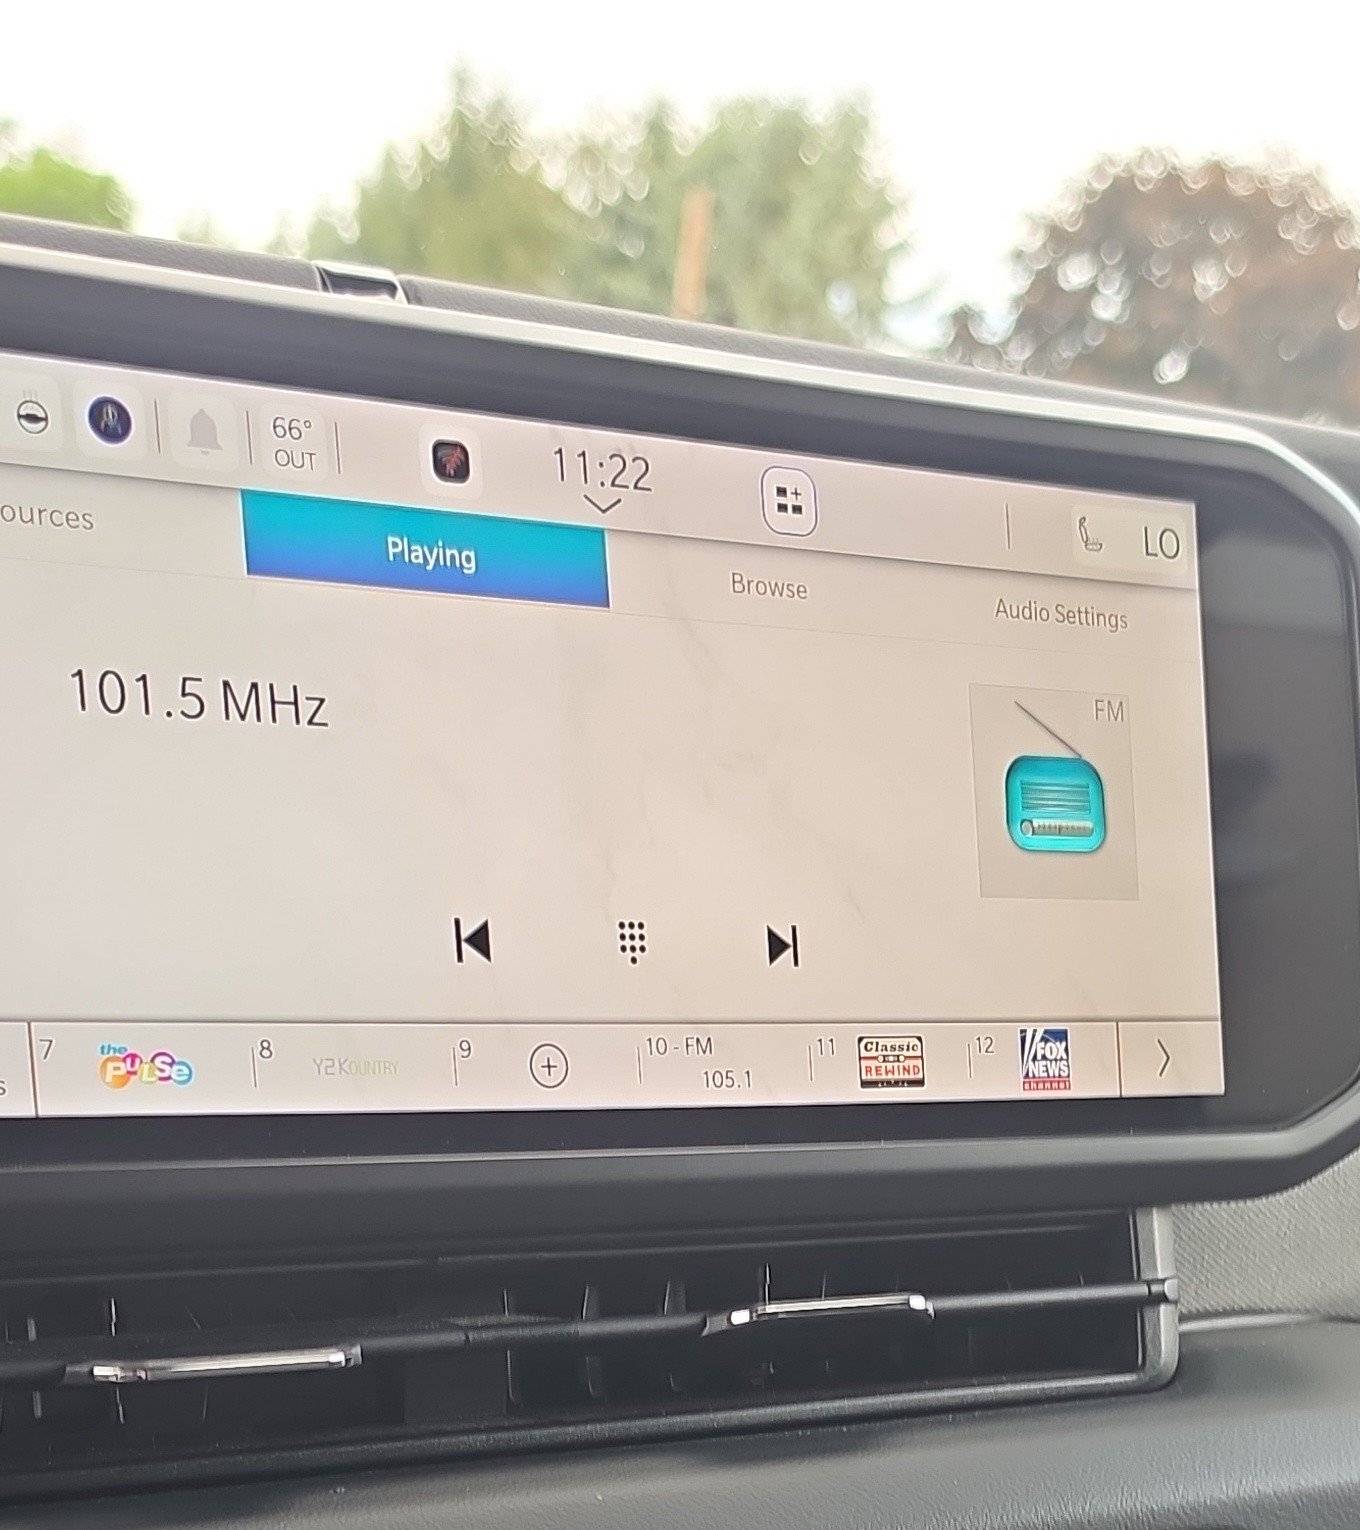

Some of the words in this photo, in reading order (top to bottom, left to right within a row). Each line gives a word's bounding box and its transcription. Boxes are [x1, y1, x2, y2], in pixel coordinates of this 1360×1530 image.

[271, 416, 313, 441] 66°
[274, 449, 317, 473] OUT
[554, 446, 653, 492] 11:22
[1143, 525, 1181, 560] LO
[386, 536, 476, 575] Playing
[731, 572, 808, 600] Browse
[995, 597, 1051, 624] Audio
[1054, 604, 1129, 633] Settings
[68, 667, 208, 721] 101.5
[221, 680, 330, 728] MHz
[1094, 699, 1125, 723] FM
[39, 1038, 54, 1060] 7
[99, 1043, 129, 1056] the
[258, 1039, 273, 1059] 8
[458, 1039, 472, 1059] 9
[645, 1036, 667, 1056] 10
[685, 1036, 713, 1056] FM
[817, 1038, 835, 1056] 11
[863, 1039, 919, 1053] Classic
[976, 1036, 995, 1054] 12
[1036, 1041, 1067, 1061] FOX
[864, 1064, 921, 1077] REWIND
[1028, 1060, 1069, 1078] NEWS
[702, 1070, 752, 1089] 105.1
[1024, 1080, 1070, 1091] channel
